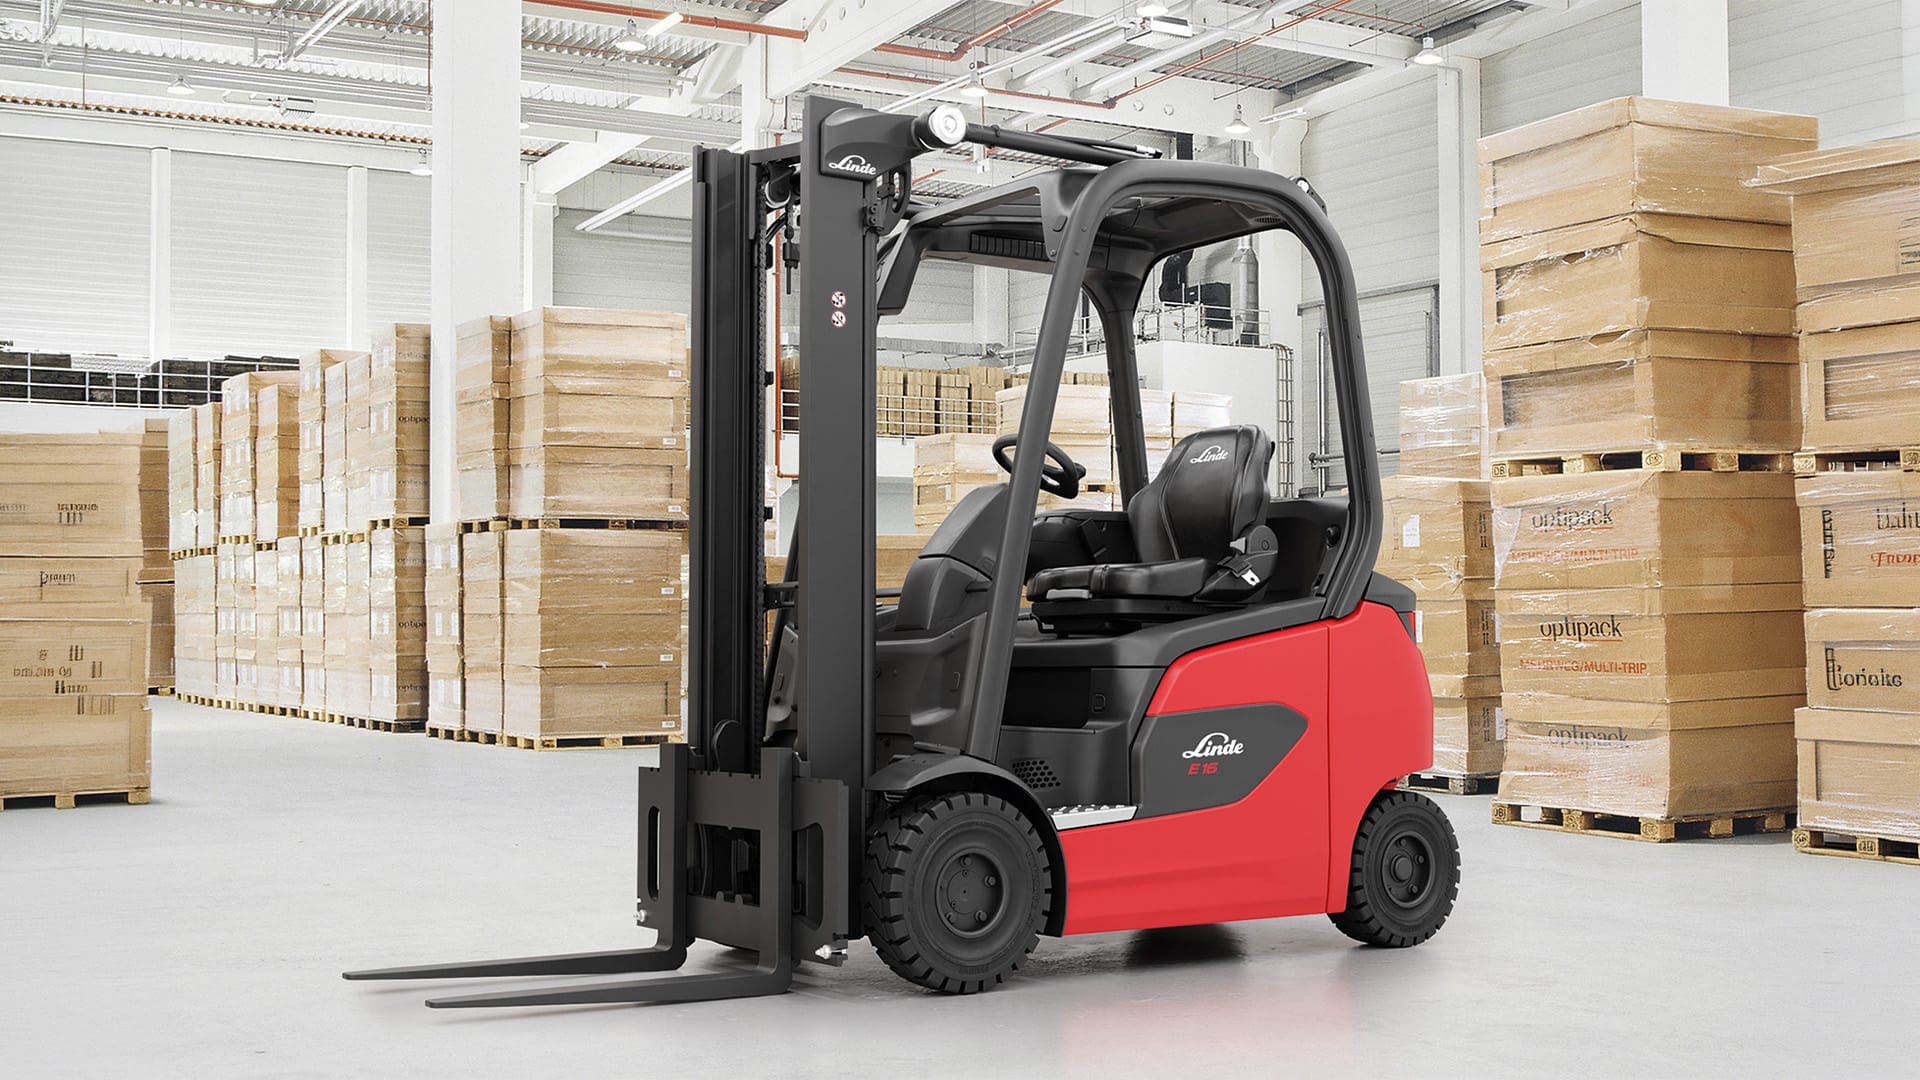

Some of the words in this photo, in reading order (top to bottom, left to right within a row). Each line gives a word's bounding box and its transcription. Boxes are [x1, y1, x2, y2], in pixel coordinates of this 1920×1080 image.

[828, 154, 877, 175] Linde
[1189, 445, 1229, 464] Linde
[1531, 501, 1615, 532] optipack
[1539, 614, 1623, 642] optipack
[1181, 732, 1245, 759] Linde
[1547, 724, 1630, 750] optipack
